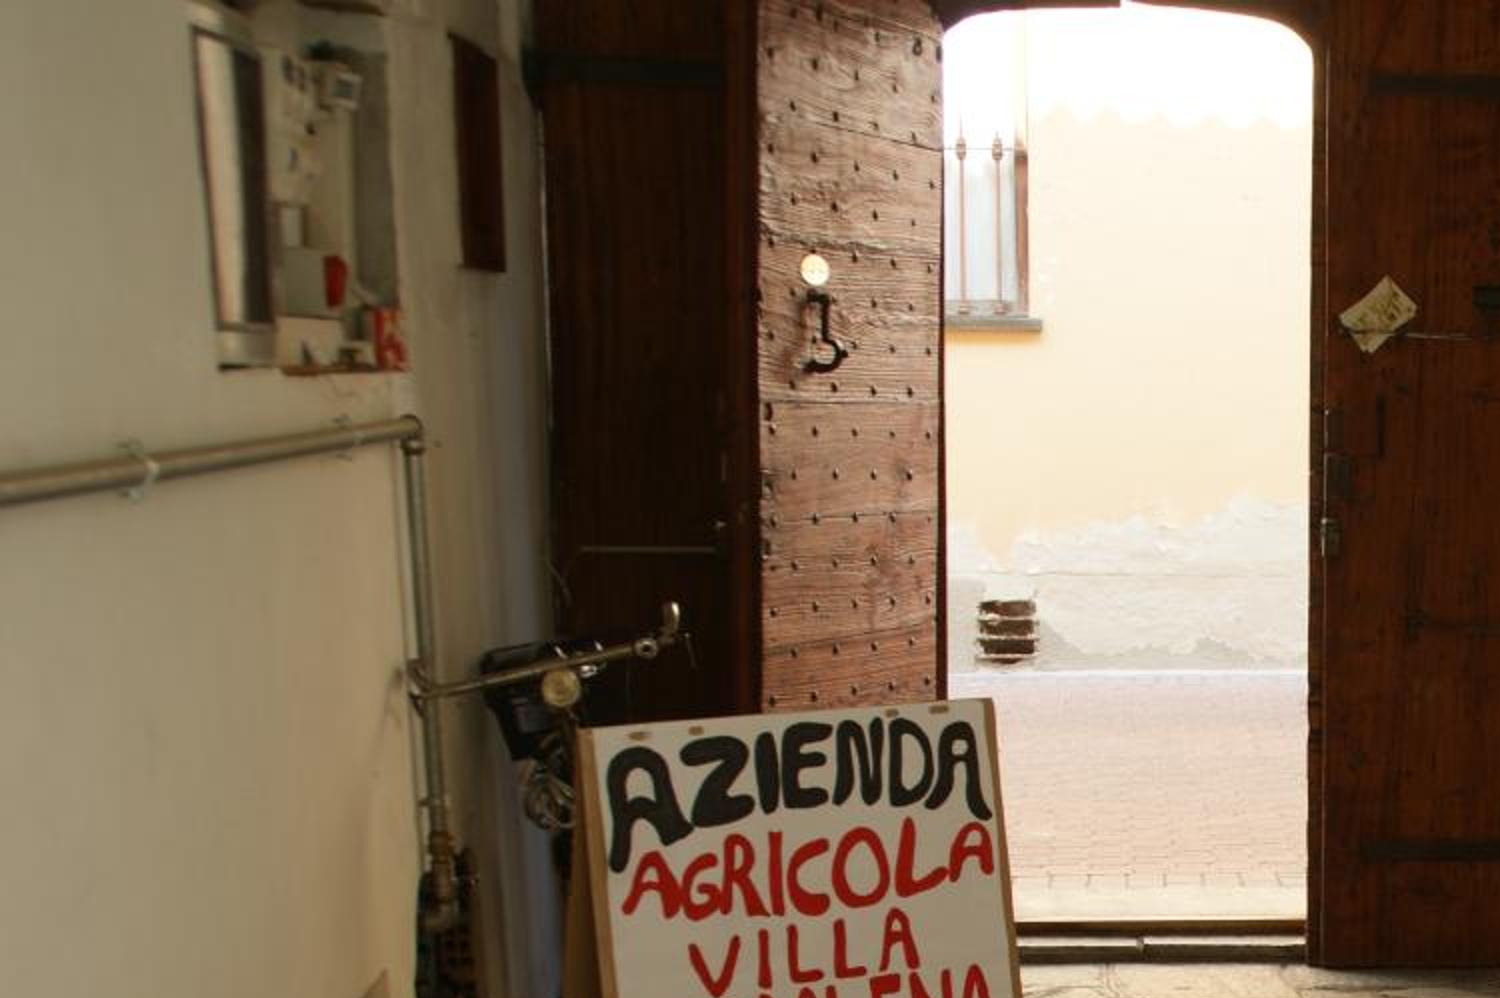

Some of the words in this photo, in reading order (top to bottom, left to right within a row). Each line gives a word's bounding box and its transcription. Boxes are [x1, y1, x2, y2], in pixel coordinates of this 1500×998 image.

[607, 718, 993, 873] AZIENDA
[621, 816, 994, 921] AGRICOLA
[688, 907, 921, 998] VILLA
